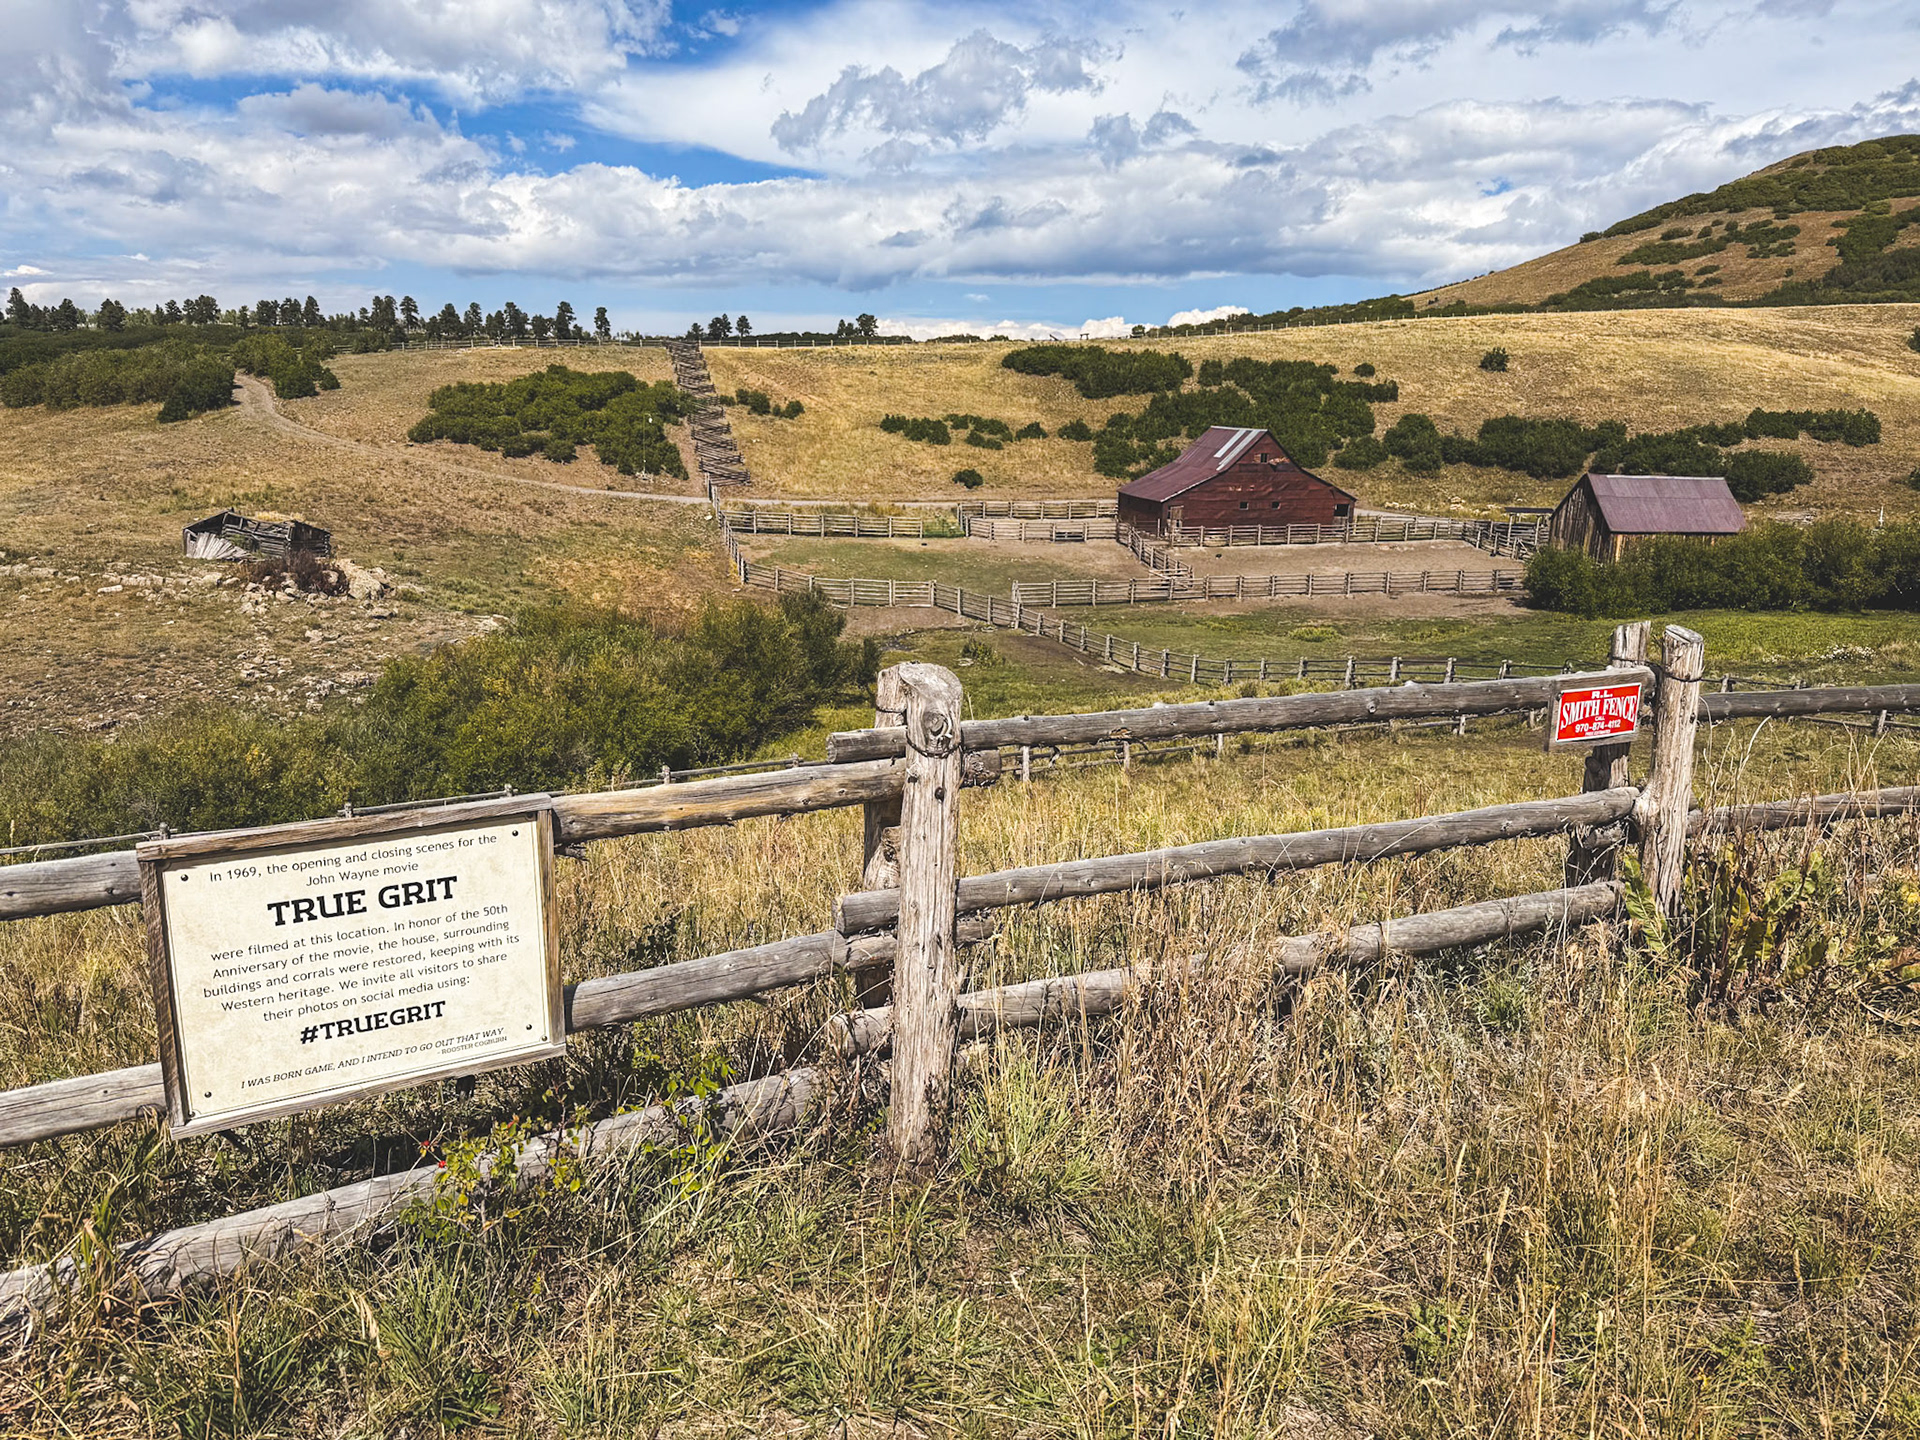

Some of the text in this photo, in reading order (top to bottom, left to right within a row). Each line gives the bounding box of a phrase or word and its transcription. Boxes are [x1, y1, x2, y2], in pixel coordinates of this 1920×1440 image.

[1560, 695, 1637, 730] SMITH FENCE
[1591, 690, 1613, 699] R.L.
[209, 834, 497, 882] In 1969, the opening and closing scenes for the
[306, 861, 419, 887] John Wayne movie
[267, 876, 457, 926] TRUE GRIT
[210, 904, 508, 961] were filmed at this location. In honor of the 50th
[212, 921, 509, 979] Anniversary of the movie, the house, surrounding
[203, 935, 520, 998] buildings and corrals were restored, keeping with its
[220, 953, 507, 1012] Western heritage. We invite all visitors to share
[263, 976, 470, 1022] their photos on social media using:
[301, 1001, 445, 1044] #TRUEGRIT
[247, 1075, 271, 1088] WAS
[272, 1069, 303, 1083] BORN
[304, 1062, 336, 1076] GAME,
[337, 1057, 360, 1069] AND
[366, 1048, 403, 1063] INTEND
[404, 1045, 418, 1055] TO
[419, 1042, 433, 1052] GO
[434, 1037, 455, 1048] OUT
[456, 1032, 481, 1044] THAT
[482, 1027, 504, 1038] WAY
[442, 1044, 473, 1054] ROOSTER
